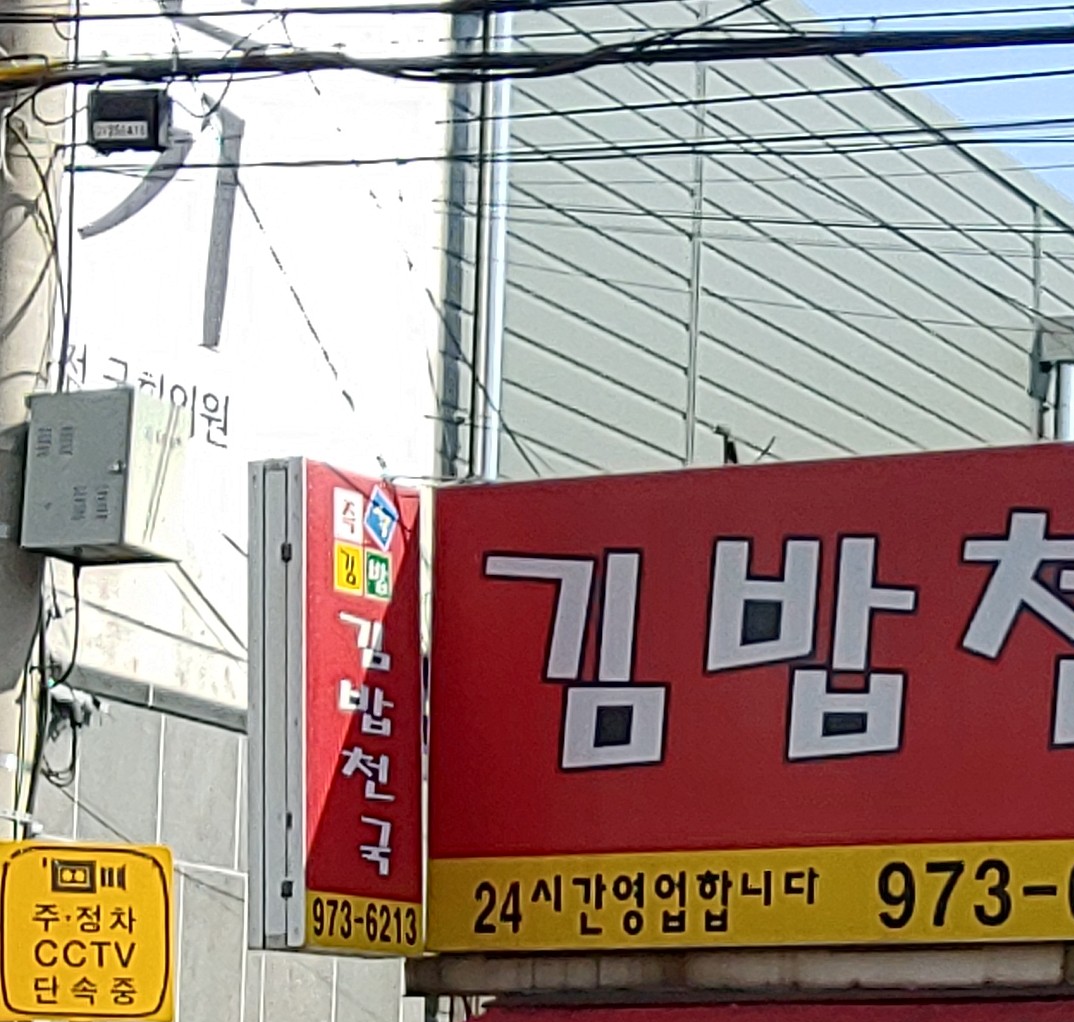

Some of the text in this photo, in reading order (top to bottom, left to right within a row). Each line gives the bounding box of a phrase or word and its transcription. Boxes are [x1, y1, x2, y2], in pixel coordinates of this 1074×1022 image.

[338, 611, 395, 876] 김밥천국
[312, 898, 418, 947] 973-6213
[34, 938, 136, 969] CCTV
